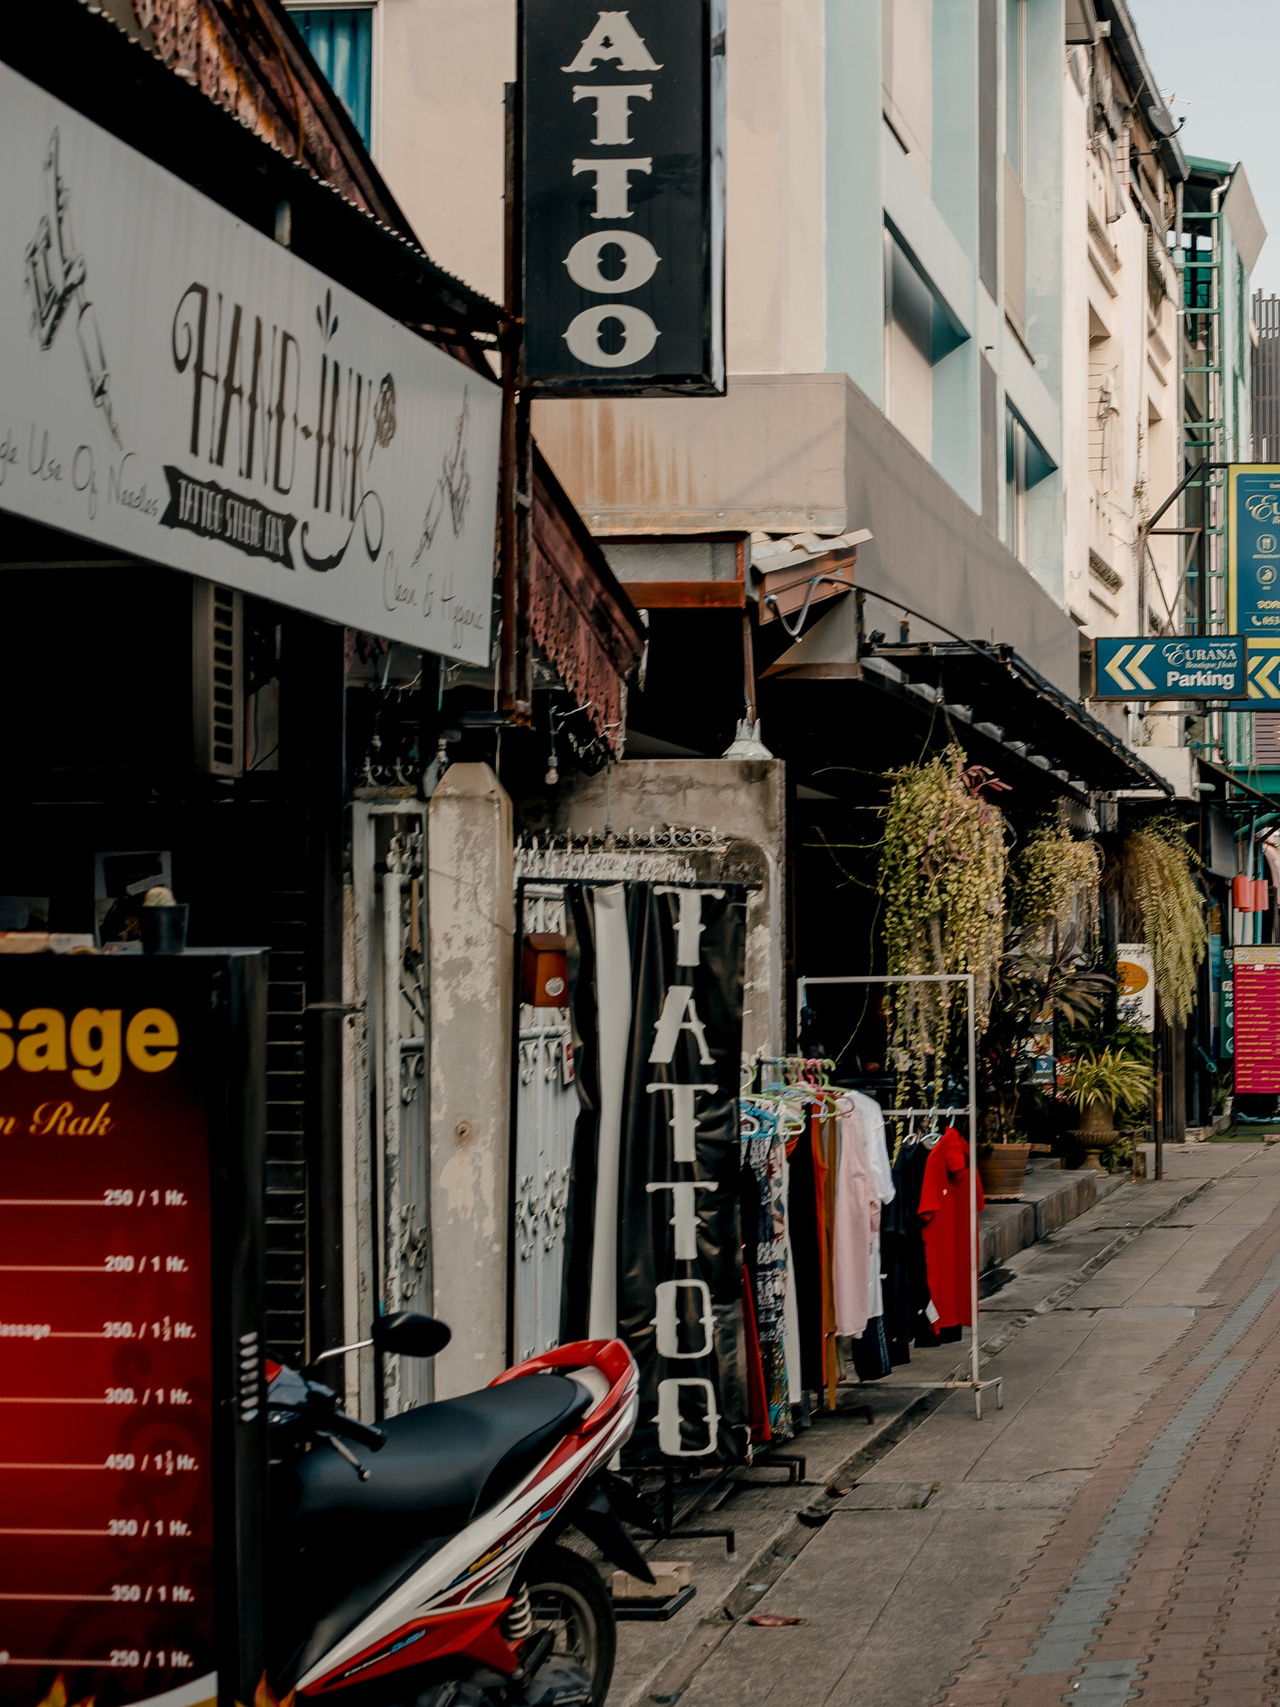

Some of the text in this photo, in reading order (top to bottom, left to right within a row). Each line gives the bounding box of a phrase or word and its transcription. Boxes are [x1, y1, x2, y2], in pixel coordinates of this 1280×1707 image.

[1162, 643, 1237, 667] EURANA
[1166, 670, 1235, 690] Parking
[29, 1100, 116, 1136] Rak
[646, 886, 726, 1457] TATTOO
[165, 1189, 188, 1206] Hr.
[165, 1255, 189, 1272] Hr.
[174, 1321, 197, 1338] Hr.
[169, 1387, 193, 1404] Hr.
[176, 1454, 199, 1471] Hr.
[169, 1519, 192, 1537] Hr.
[172, 1585, 195, 1602] Hr.
[171, 1650, 194, 1667] Hr.
